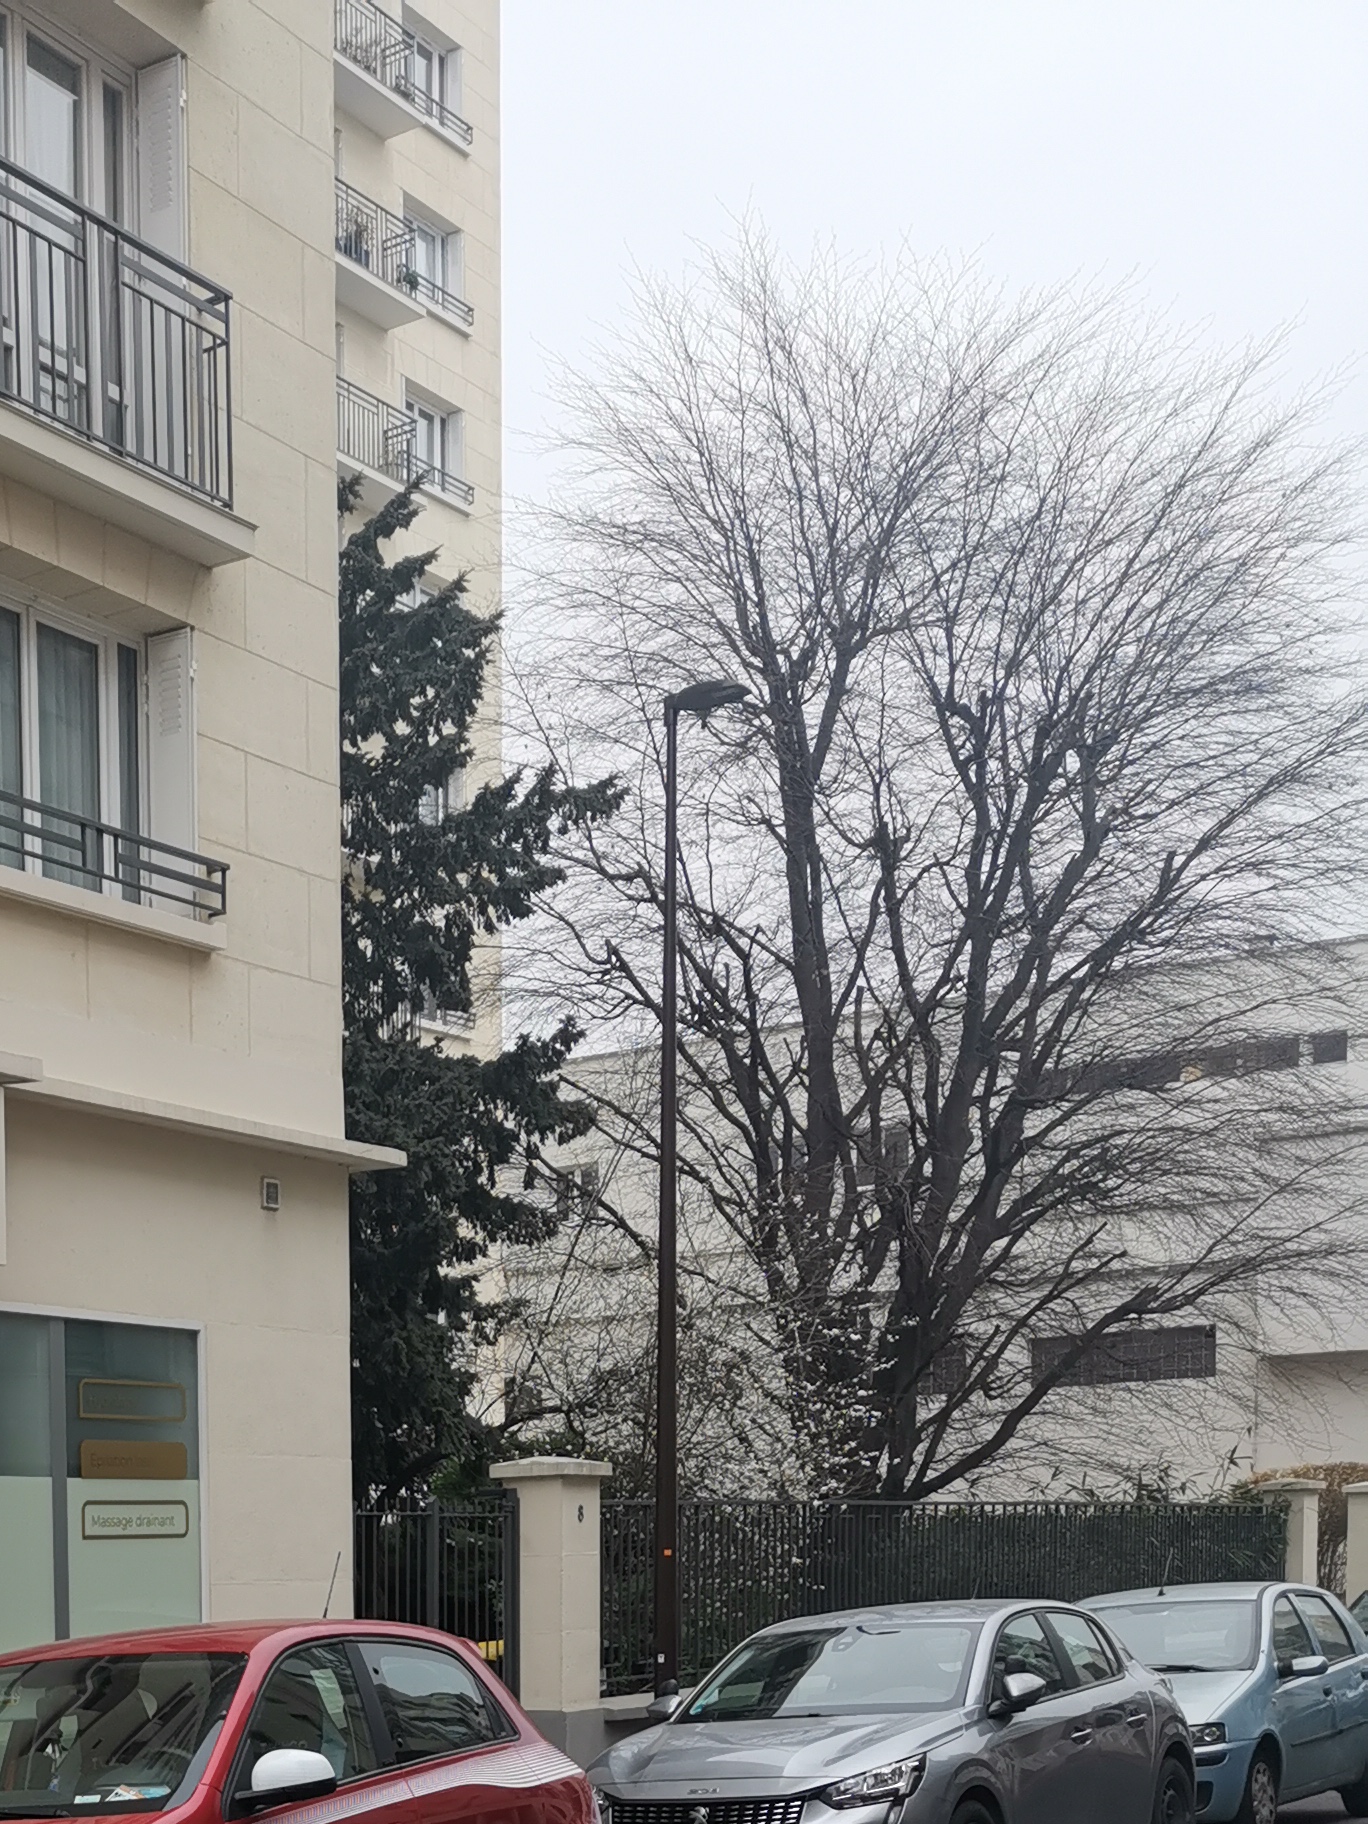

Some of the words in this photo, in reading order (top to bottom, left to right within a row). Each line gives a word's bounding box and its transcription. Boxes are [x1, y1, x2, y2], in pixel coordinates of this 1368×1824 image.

[91, 1514, 134, 1531] Massage
[135, 1513, 176, 1528] drainant
[577, 1504, 584, 1523] 8
